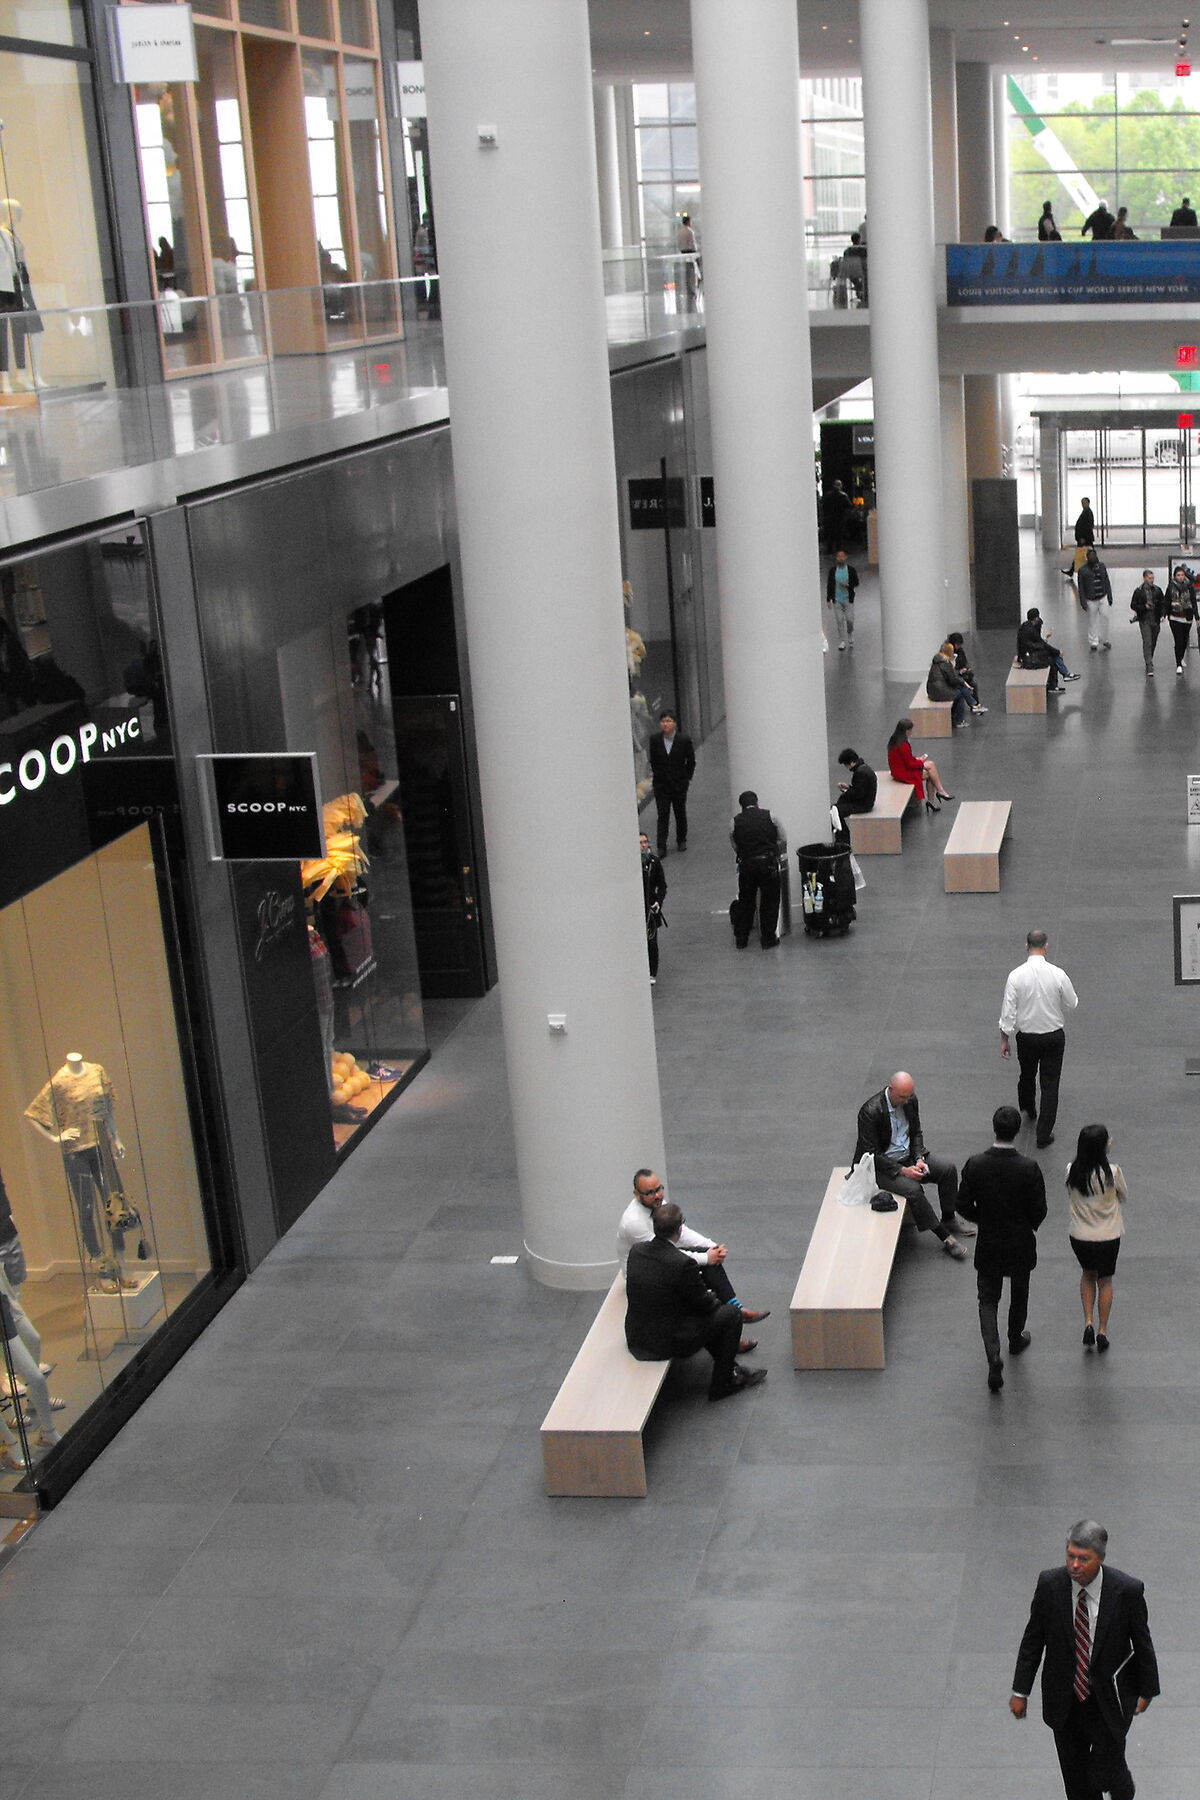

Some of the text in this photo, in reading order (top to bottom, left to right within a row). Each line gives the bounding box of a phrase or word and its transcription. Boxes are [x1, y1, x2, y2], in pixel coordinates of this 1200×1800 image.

[402, 85, 425, 94] BON
[985, 287, 1020, 296] VUITTON
[1086, 286, 1115, 294] WORLD
[1145, 285, 1165, 293] NEW
[1168, 285, 1188, 293] YORK
[101, 717, 140, 752] NYC
[227, 802, 287, 813] SCOOP
